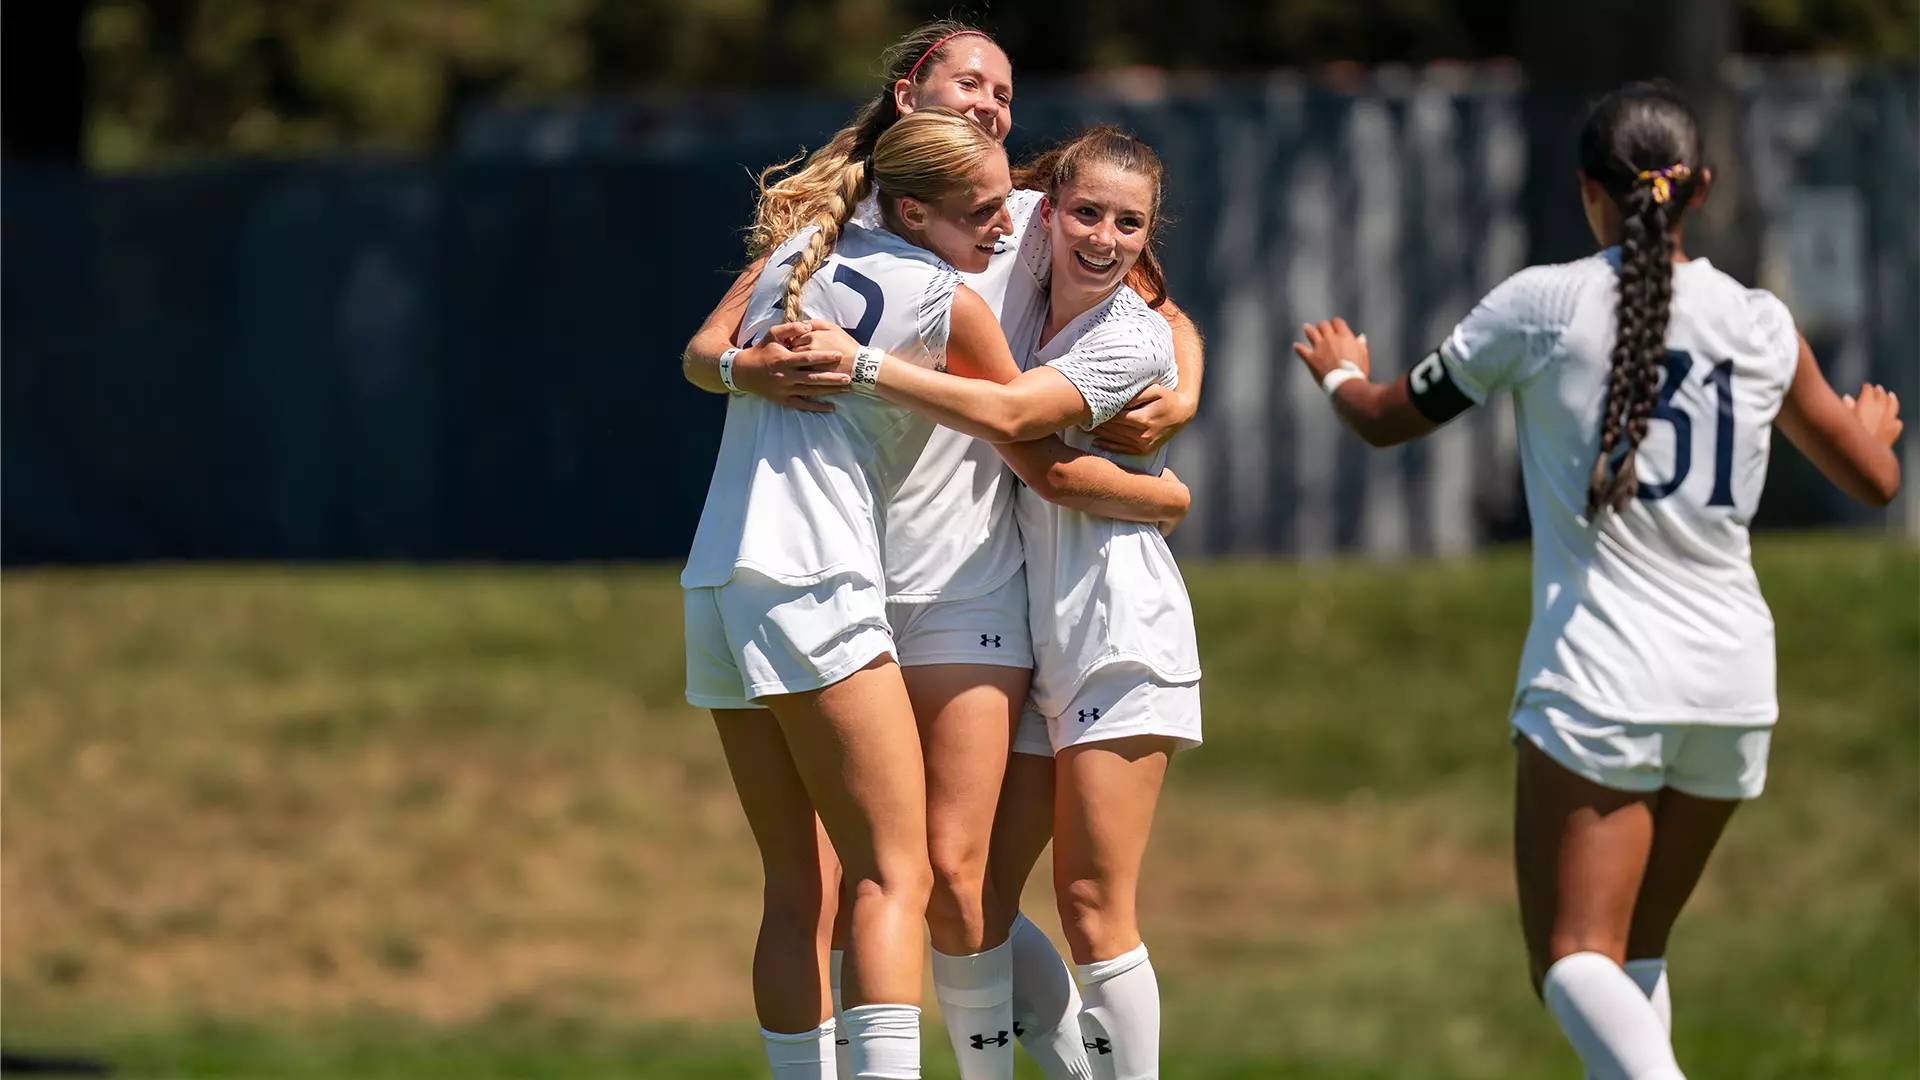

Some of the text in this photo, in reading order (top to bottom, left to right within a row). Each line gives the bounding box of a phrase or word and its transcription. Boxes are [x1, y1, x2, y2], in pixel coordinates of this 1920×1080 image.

[863, 360, 879, 385] 8:31
[1410, 351, 1444, 395] C
[1612, 349, 1735, 507] 31
